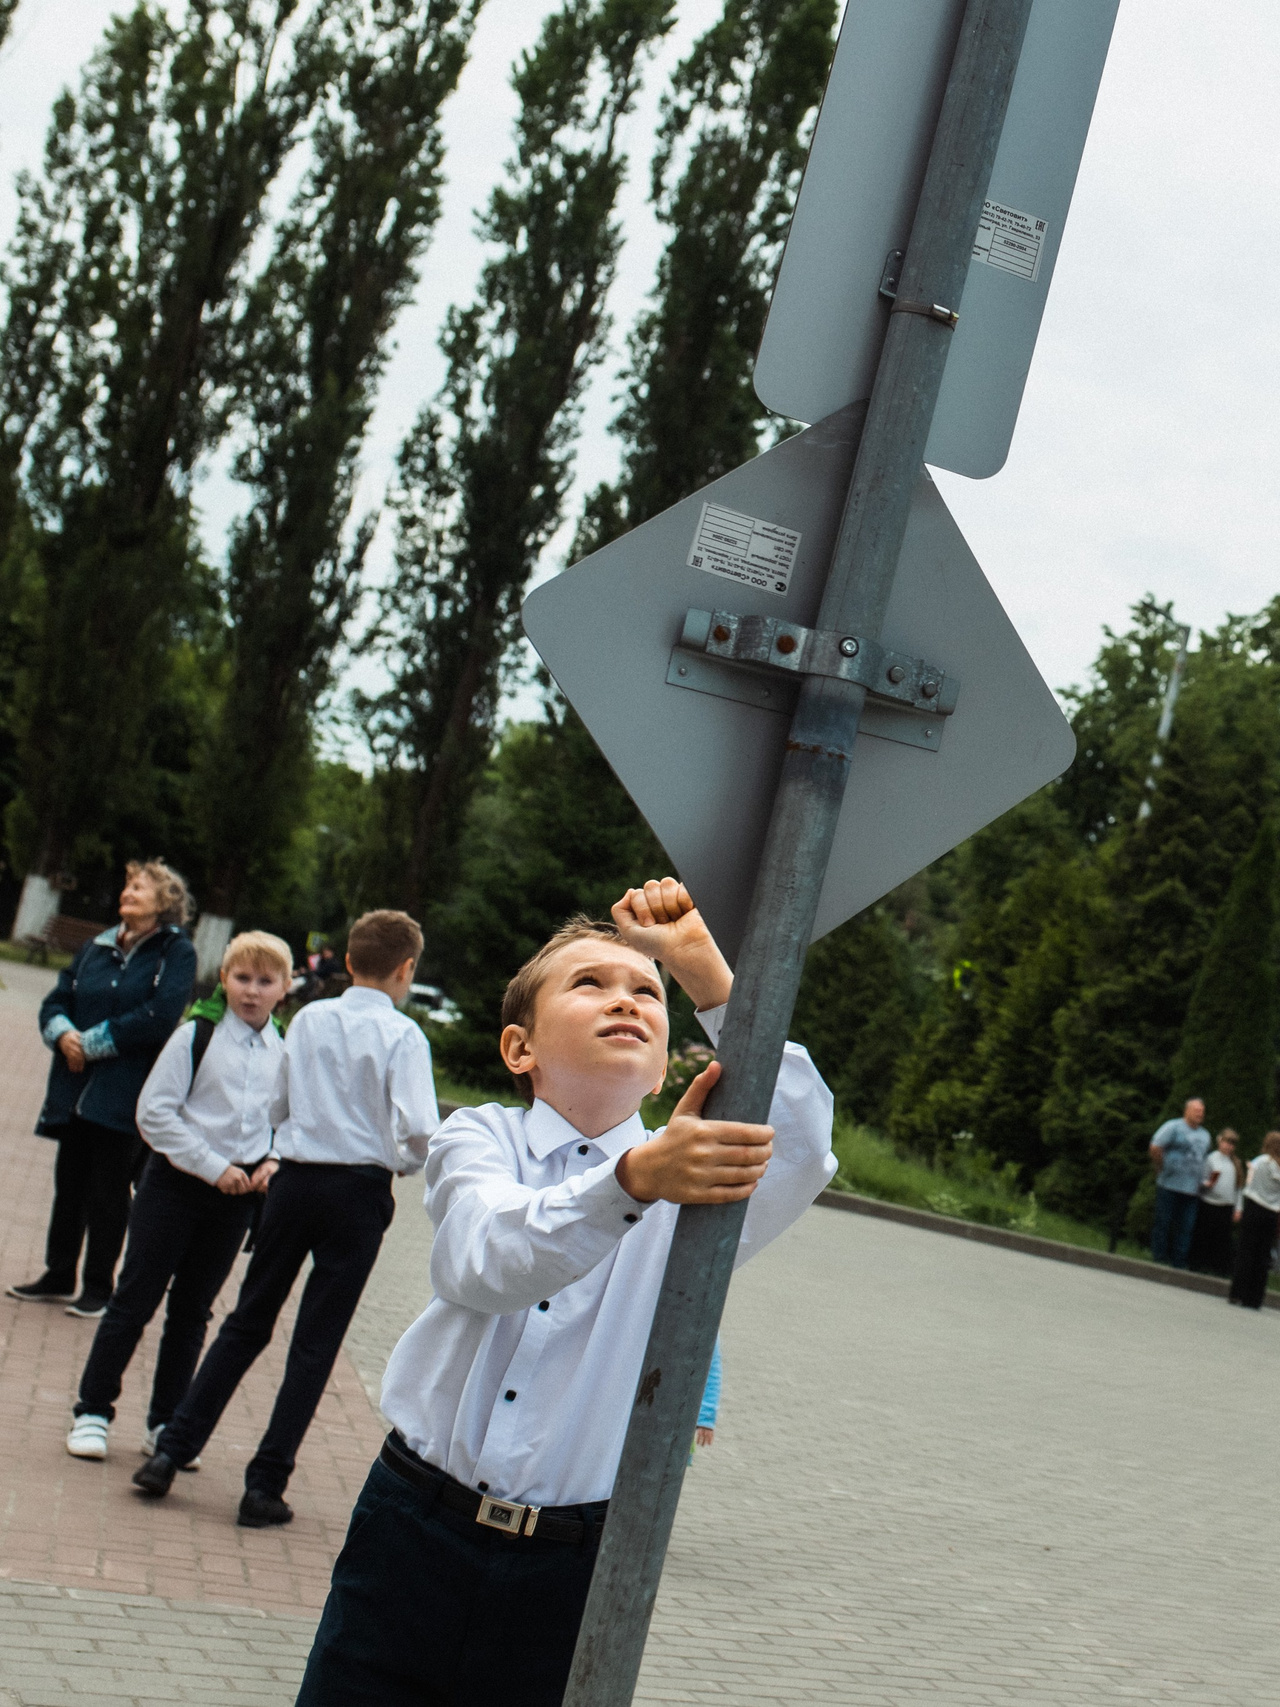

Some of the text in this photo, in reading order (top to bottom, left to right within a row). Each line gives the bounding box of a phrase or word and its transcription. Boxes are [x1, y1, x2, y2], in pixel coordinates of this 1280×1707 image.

[991, 204, 1028, 222] «Световит»
[710, 564, 750, 582] «Световит»
[750, 577, 768, 587] ООО
